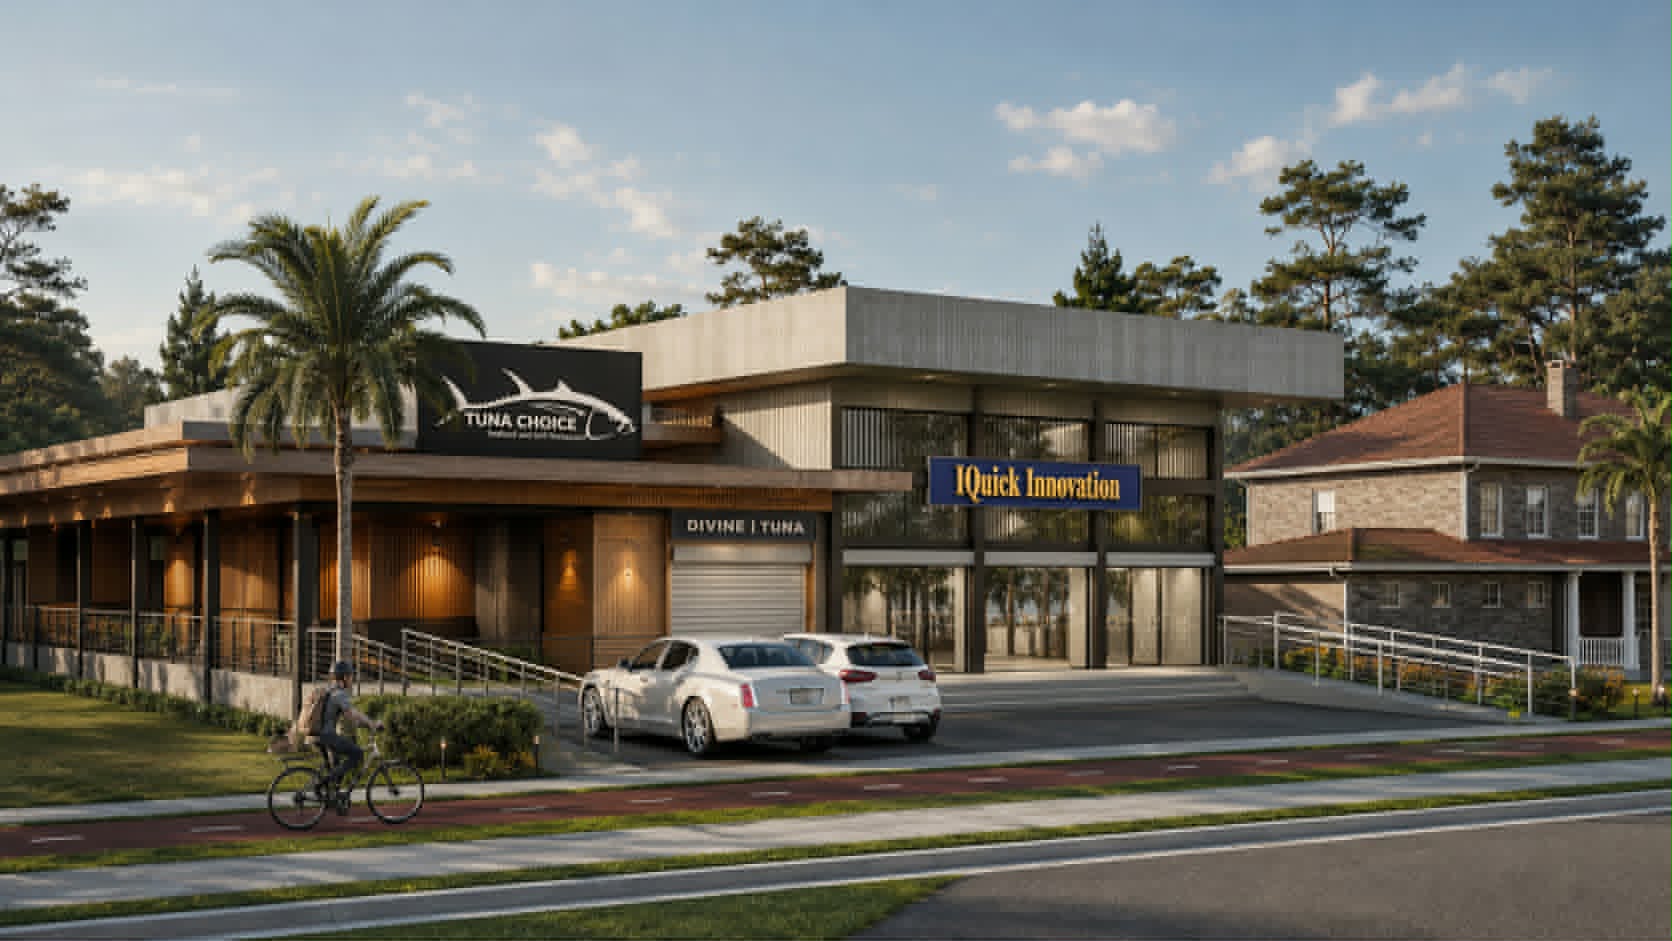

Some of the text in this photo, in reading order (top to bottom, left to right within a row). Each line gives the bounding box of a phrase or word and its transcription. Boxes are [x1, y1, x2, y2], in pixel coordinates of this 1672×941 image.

[464, 412, 576, 431] TUNA CHOICE
[954, 464, 1120, 503] IQuick Innovation
[687, 519, 744, 534] DIVINE
[760, 519, 805, 536] TUNA
